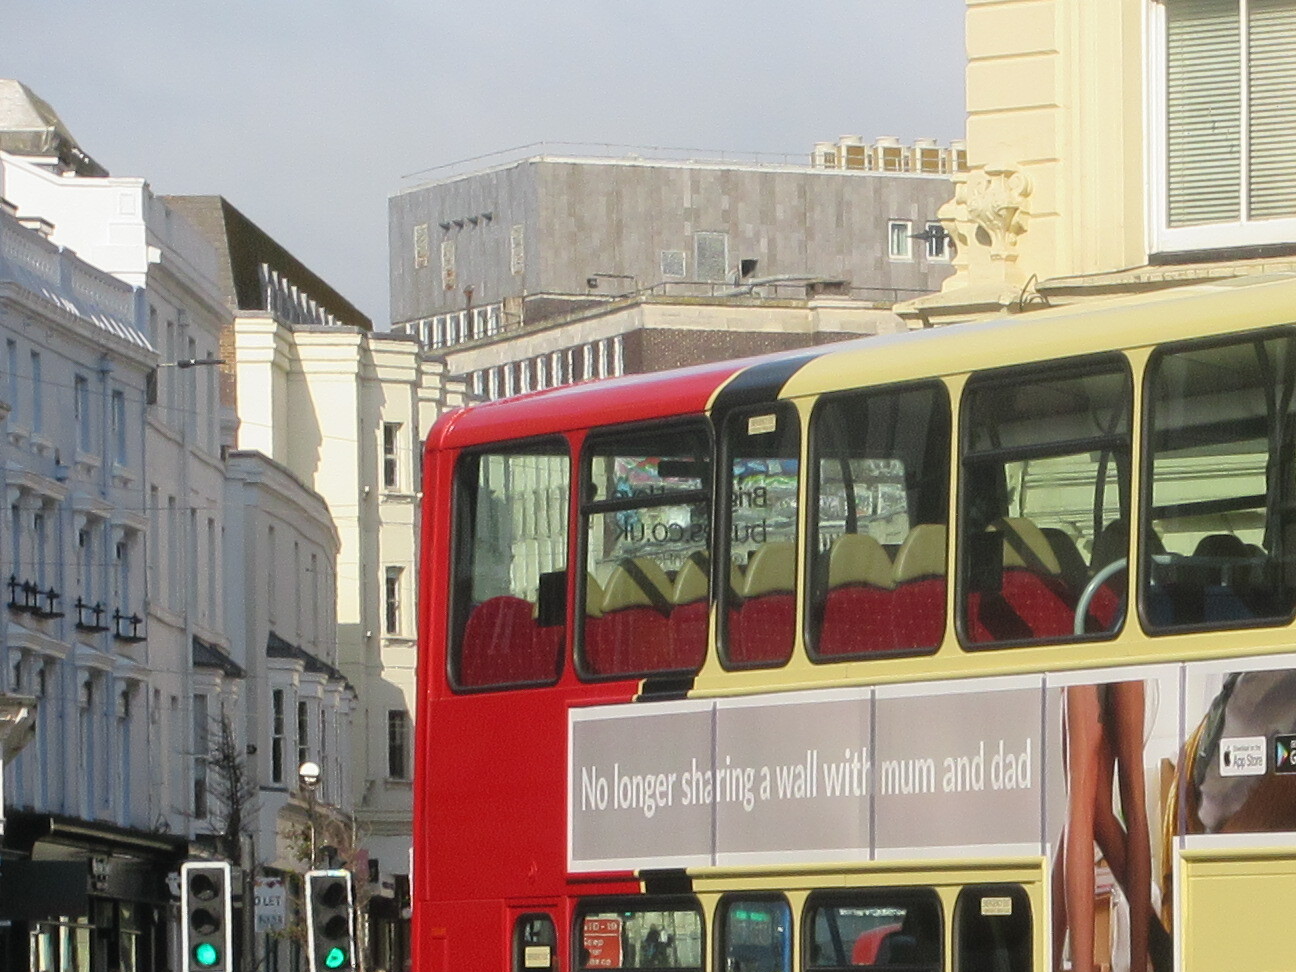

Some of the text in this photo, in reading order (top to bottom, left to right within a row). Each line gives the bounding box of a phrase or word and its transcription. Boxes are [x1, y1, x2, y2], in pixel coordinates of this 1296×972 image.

[581, 737, 1031, 818] No longer sharing a wall with mum and dad
[1233, 753, 1263, 770] App Store
